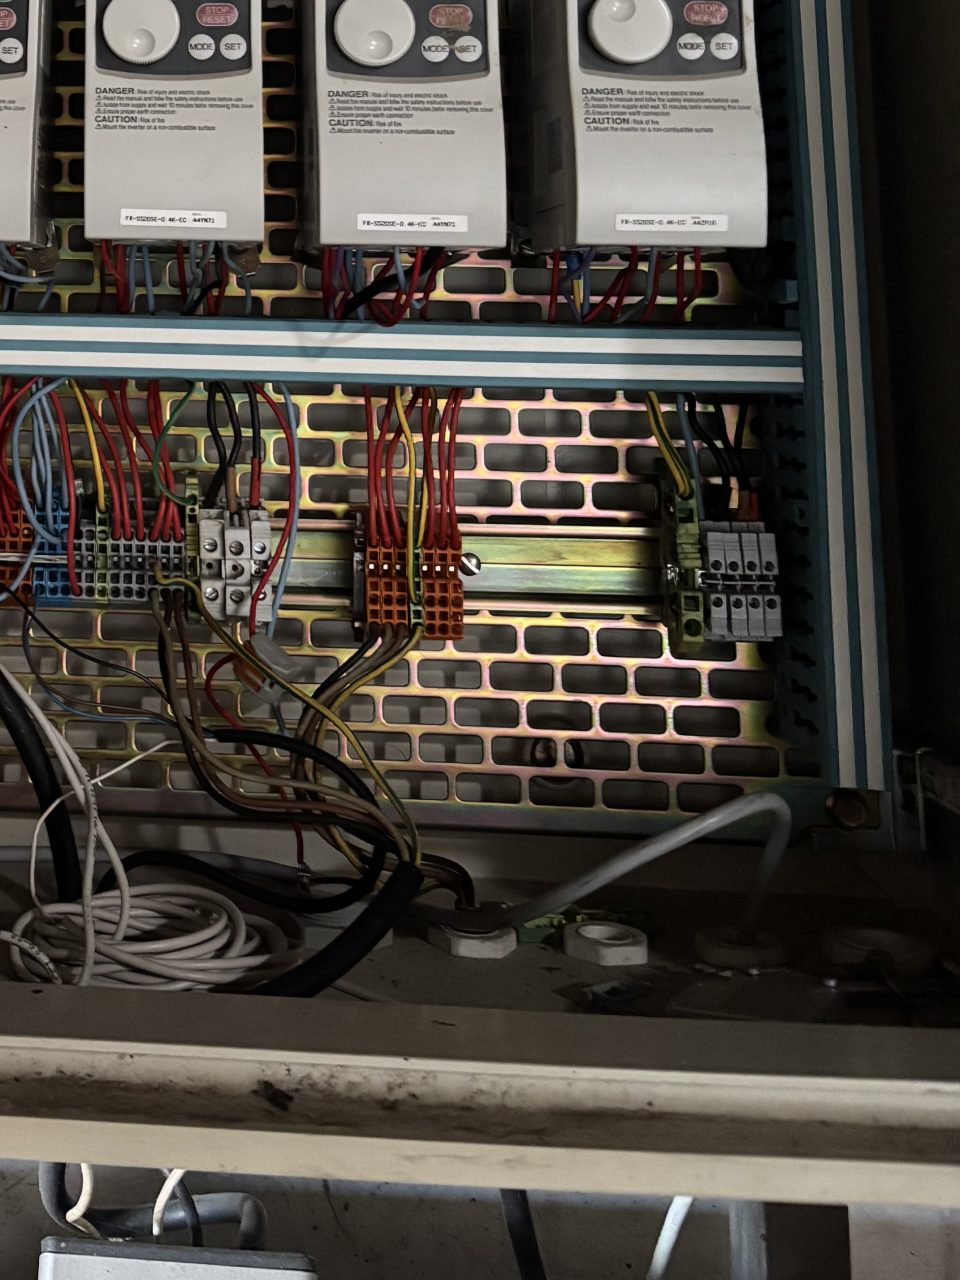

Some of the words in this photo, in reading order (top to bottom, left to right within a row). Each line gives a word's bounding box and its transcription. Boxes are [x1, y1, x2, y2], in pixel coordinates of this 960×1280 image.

[423, 45, 448, 53] MODE
[678, 42, 704, 50] MODE
[95, 115, 137, 123] CAUTION
[584, 117, 629, 125] CAUTION
